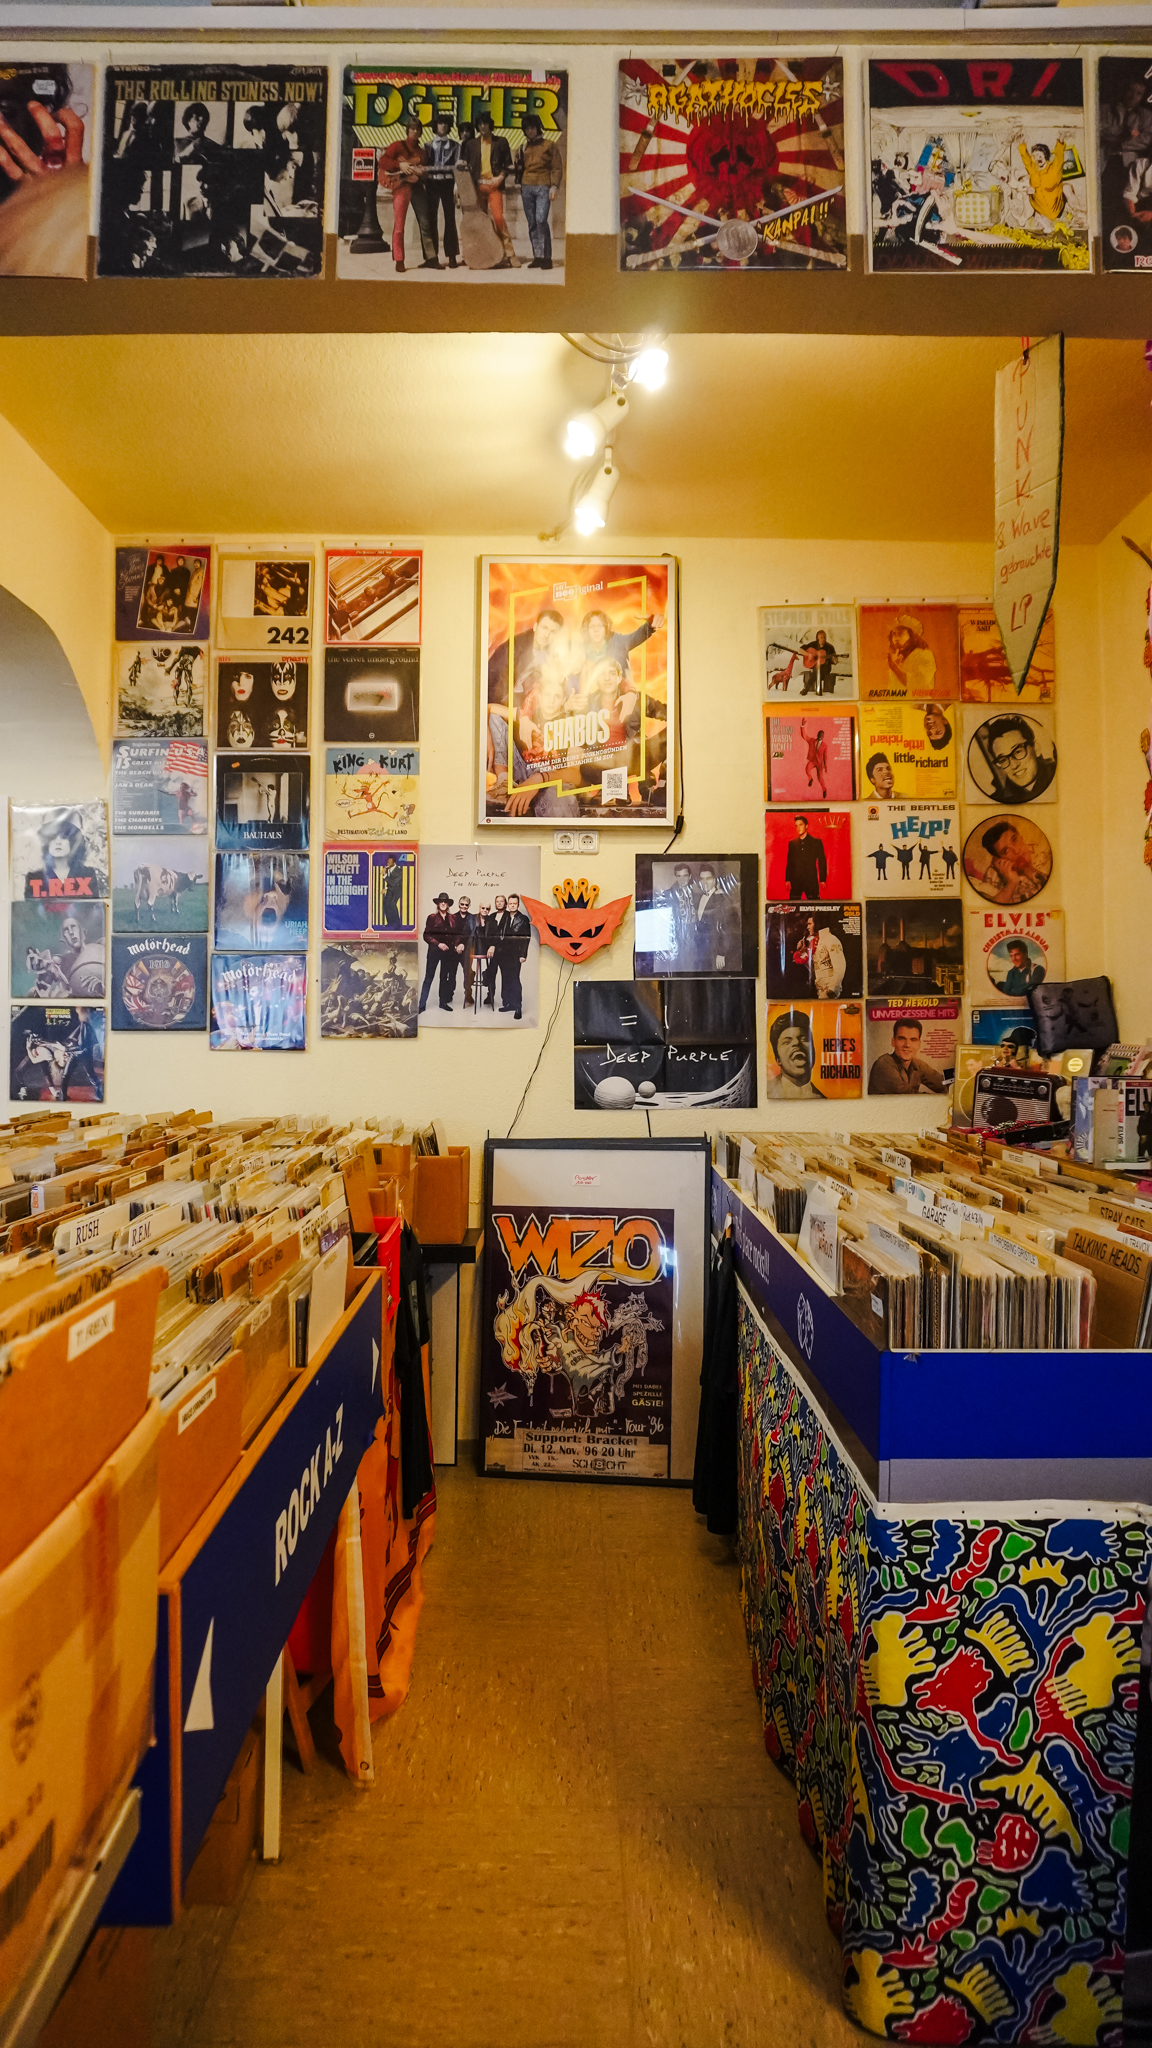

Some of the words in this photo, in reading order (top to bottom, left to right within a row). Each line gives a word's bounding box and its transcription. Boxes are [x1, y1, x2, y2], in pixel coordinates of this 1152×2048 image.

[114, 80, 145, 100] THE
[150, 80, 217, 100] ROLLING
[285, 82, 323, 102] NOW!
[351, 84, 560, 130] TOGETHER
[648, 79, 823, 128] AGATHOCLES
[1012, 357, 1034, 506] PUNK
[1012, 509, 1051, 539] Wave
[1000, 542, 1052, 583] gebrauchte
[1011, 593, 1033, 632] LP
[267, 627, 309, 645] 242
[868, 689, 908, 697] RASTAMAN
[543, 708, 611, 751] CHABOS
[333, 753, 364, 774] KING
[379, 753, 414, 772] KURT
[894, 752, 915, 763] little
[916, 757, 949, 767] richard
[243, 831, 282, 839] BAUHAUS
[891, 816, 951, 840] HELP!
[327, 854, 358, 864] WILSON
[327, 864, 360, 874] PICKETT
[446, 868, 469, 878] DEEP
[29, 876, 94, 898] T.REX
[327, 875, 335, 885] IN
[337, 875, 352, 885] THE
[326, 885, 368, 895] MIDNIGHT
[326, 895, 349, 905] HOUR
[285, 920, 307, 929] URIAH
[982, 928, 1024, 953] CHRISTMAS
[1025, 930, 1049, 952] ALBUM
[887, 999, 904, 1007] TED
[905, 998, 939, 1007] HEROLD
[872, 1009, 936, 1018] UNVERGESSENE
[937, 1008, 955, 1017] HITS
[823, 1038, 856, 1052] HERE'S
[600, 1043, 650, 1066] DEEP
[667, 1045, 733, 1062] PURPLE
[821, 1052, 853, 1065] LITTLE
[820, 1065, 861, 1079] RICHARD
[922, 1205, 948, 1228] GARAGE
[1100, 1206, 1123, 1222] STRAY
[76, 1218, 99, 1246] RUSH
[492, 1213, 667, 1286] WIZO
[1073, 1232, 1107, 1262] TALKING
[1109, 1245, 1142, 1275] HEADS
[85, 1314, 109, 1341] REX
[625, 1418, 646, 1433] Tour
[525, 1432, 582, 1444] Support:
[586, 1435, 638, 1446] Bracket
[524, 1444, 537, 1454] Di.
[540, 1444, 556, 1454] 12.
[559, 1445, 580, 1456] Nov.
[601, 1447, 615, 1457] 20
[618, 1447, 636, 1458] Uhr
[275, 1443, 321, 1587] ROCK
[323, 1402, 344, 1489] A-Z
